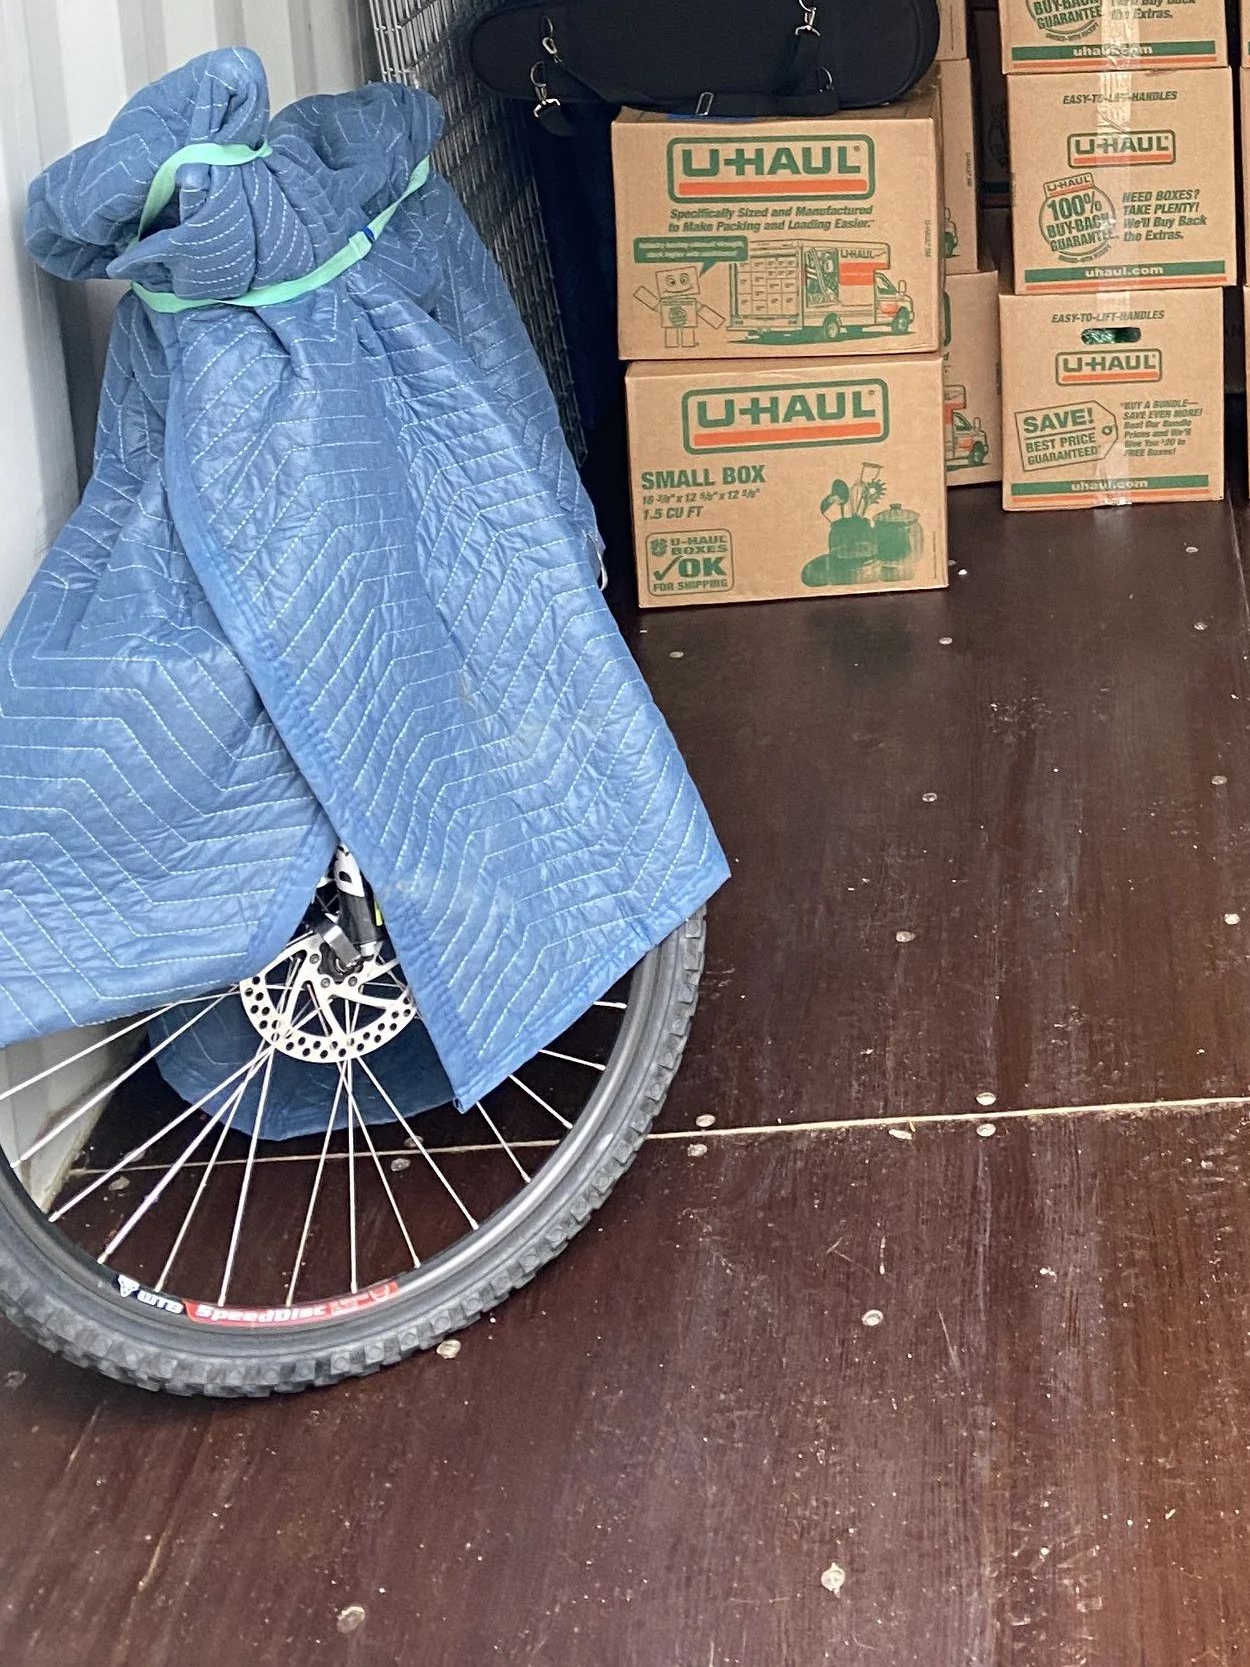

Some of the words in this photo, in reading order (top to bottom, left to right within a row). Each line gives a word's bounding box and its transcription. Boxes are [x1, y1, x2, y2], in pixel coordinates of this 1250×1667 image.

[1037, 6, 1101, 30] GUARANTEE
[1075, 136, 1169, 155] U-HAUL
[682, 146, 861, 176] U-HAUL
[1047, 175, 1090, 191] U-HAUL
[1123, 191, 1152, 202] NEED
[1156, 189, 1200, 201] BOXES?
[670, 209, 735, 219] Specifically
[738, 208, 768, 217] Sized
[771, 207, 791, 216] and
[796, 205, 873, 216] Manufactured
[1047, 191, 1101, 221] 100%
[1124, 204, 1151, 215] TAKE
[1154, 203, 1199, 214] PLENTY!
[669, 222, 680, 232] to
[683, 221, 713, 231] Make
[716, 221, 760, 232] Packing
[764, 220, 785, 230] and
[788, 219, 830, 231] Loading
[1154, 217, 1175, 228] Buy
[1179, 215, 1207, 226] Back
[1124, 231, 1141, 242] the
[1085, 266, 1163, 278] uhaul.com
[1063, 354, 1156, 372] U-HAUL
[698, 391, 876, 428] U-HAUL
[1024, 408, 1093, 434] SAVE!
[1026, 439, 1055, 453] BEST
[1060, 434, 1095, 448] PRICE
[641, 468, 715, 490] SMALL
[722, 465, 766, 485] BOX
[1072, 480, 1148, 491] uhaul.com
[644, 509, 663, 520] 1.5
[666, 507, 684, 519] CU
[688, 506, 704, 518] FT
[671, 536, 727, 546] U-HAUL
[672, 545, 728, 555] BOXES
[679, 557, 727, 577] OK
[654, 582, 674, 592] FOR
[678, 579, 728, 590] SHIPPING
[138, 1292, 183, 1314] WTB
